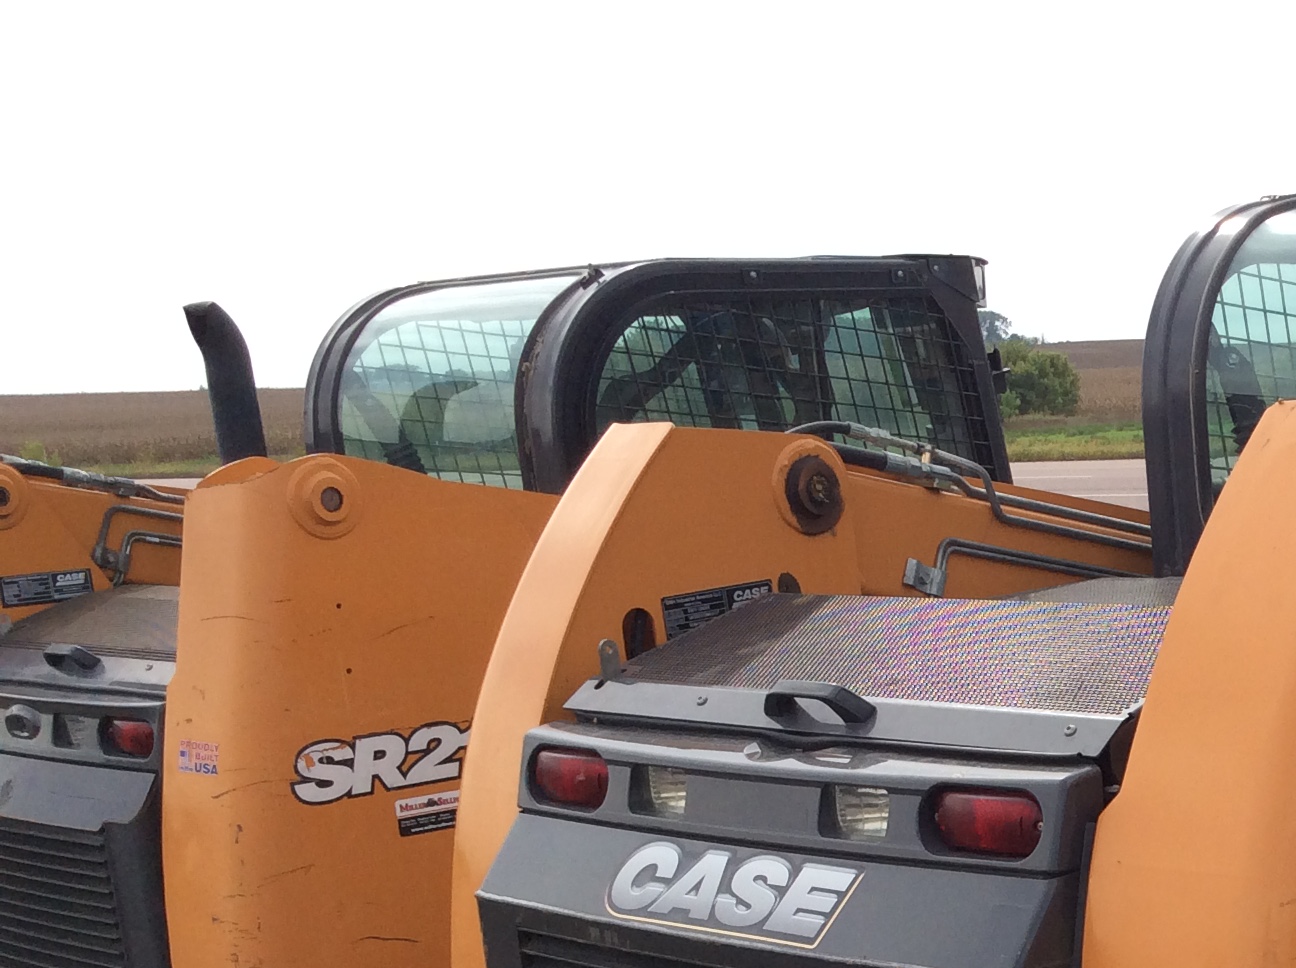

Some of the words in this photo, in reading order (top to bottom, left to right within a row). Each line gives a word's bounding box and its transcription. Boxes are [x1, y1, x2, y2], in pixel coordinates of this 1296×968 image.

[57, 573, 85, 581] CASE
[733, 586, 769, 601] CASE
[194, 762, 218, 775] USA
[291, 721, 469, 805] SR2
[611, 841, 859, 938] CASE
